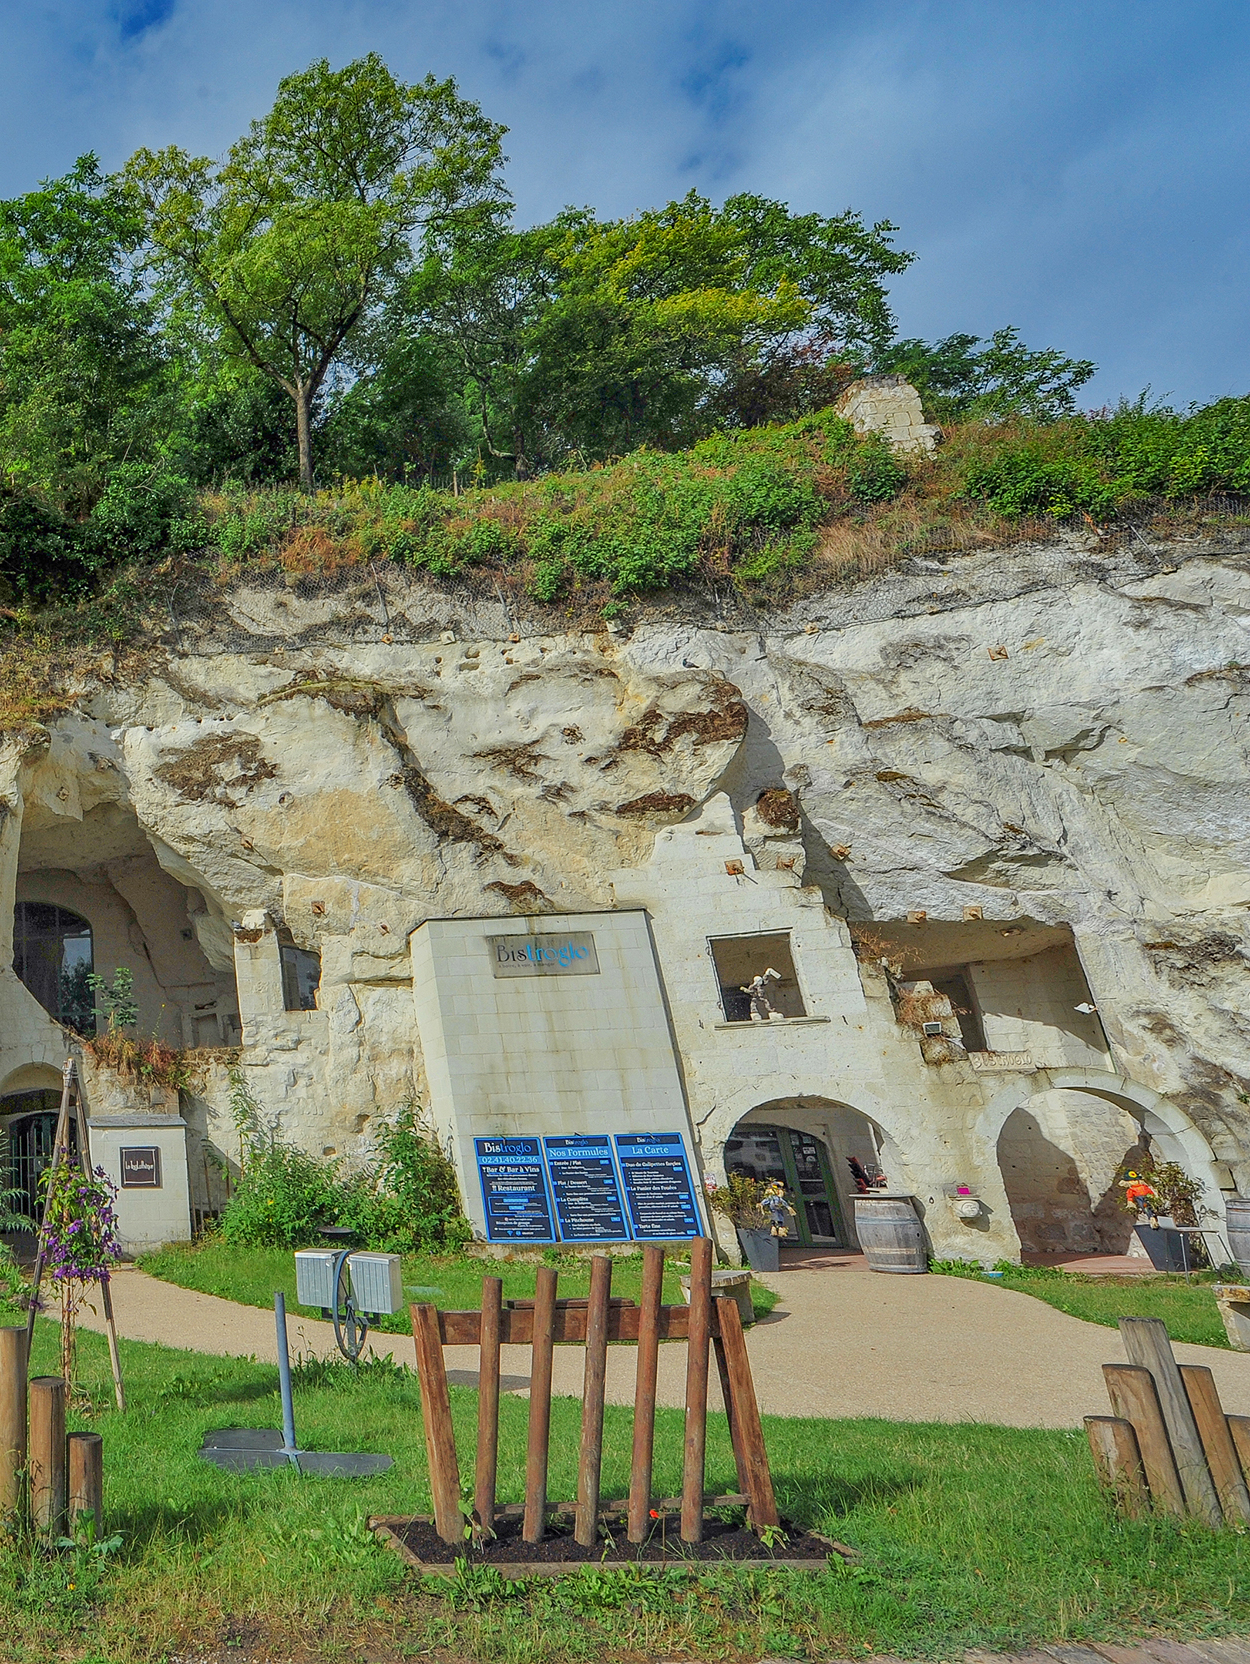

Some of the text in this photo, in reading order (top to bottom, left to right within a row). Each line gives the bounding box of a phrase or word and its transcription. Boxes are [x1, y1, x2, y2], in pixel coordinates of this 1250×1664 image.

[497, 941, 589, 967] Bistroglo
[483, 1142, 532, 1156] Bistroglo
[550, 1147, 609, 1157] Nos Formules
[644, 1146, 669, 1154] Carte
[499, 1165, 506, 1173] &
